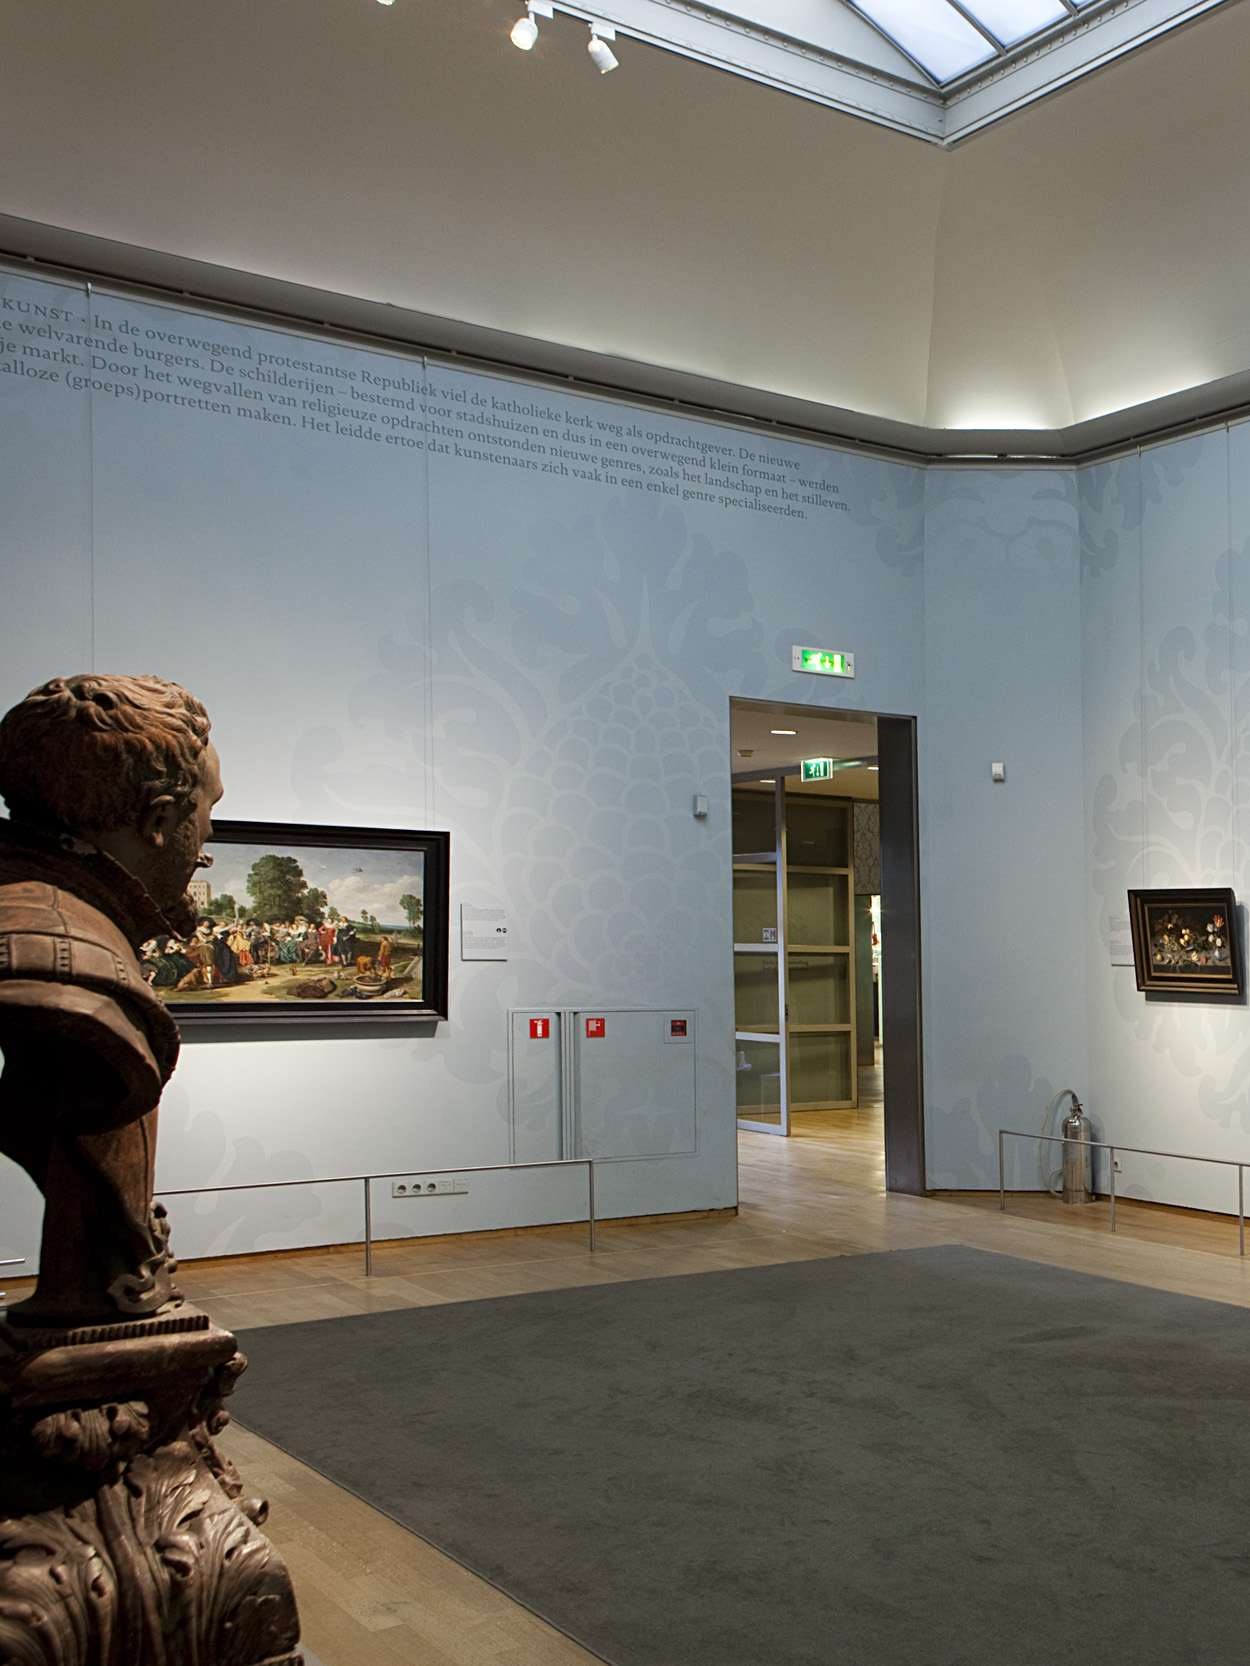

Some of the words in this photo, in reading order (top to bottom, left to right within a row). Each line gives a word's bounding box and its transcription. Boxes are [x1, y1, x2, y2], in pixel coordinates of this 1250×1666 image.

[0, 360, 59, 382] alloze
[237, 407, 296, 426] maken.
[302, 416, 331, 432] Het
[336, 421, 381, 442] leidde
[385, 427, 424, 449] ertoe
[428, 439, 450, 454] dat
[454, 443, 537, 470] kunstenaars
[541, 461, 568, 476] zich
[572, 468, 602, 482] vaak
[605, 472, 617, 485] in
[621, 478, 643, 489] een
[647, 481, 679, 496] enkel
[682, 489, 715, 502] genre
[718, 496, 807, 519] specialiseerden.
[18, 324, 128, 354] welvarende
[133, 342, 204, 369] burgers.
[210, 359, 234, 375] De
[239, 367, 334, 395] schilderijen
[351, 386, 415, 411] bestemd
[419, 404, 451, 418] voor
[456, 412, 538, 435] stadshuizen
[543, 429, 558, 439] en
[562, 429, 585, 444] dus
[590, 434, 601, 447] in
[606, 441, 627, 452] een
[632, 444, 706, 467] overwegend
[710, 457, 739, 474] klein
[743, 464, 786, 483] formaat
[798, 479, 838, 493] werden
[22, 345, 84, 366] markt.
[92, 355, 138, 376] Door
[144, 365, 172, 383] het
[177, 376, 263, 400] wegvallen
[268, 394, 296, 407] van
[302, 399, 377, 422] religieuze
[381, 415, 463, 438] opdrachten
[468, 432, 545, 454] ontstonden
[550, 446, 598, 464] nieuwe
[601, 457, 645, 474] genres,
[649, 465, 680, 479] zoals
[682, 468, 701, 483] het
[704, 473, 762, 497] landschap
[765, 489, 778, 498] en
[782, 487, 798, 502] het
[802, 494, 850, 511] stilleven.
[95, 315, 112, 331] In
[118, 320, 140, 336] de
[145, 330, 252, 360] overwegend
[257, 353, 356, 380] protestantse
[362, 370, 437, 397] Republiek
[441, 389, 466, 403] viel
[471, 393, 487, 407] de
[492, 396, 561, 422] katholieke
[565, 411, 593, 428] kerk
[597, 422, 623, 437] weg
[626, 425, 642, 438] als
[646, 432, 735, 456] opdrachtgever.
[739, 448, 755, 461] De
[759, 454, 800, 470] nieuwe
